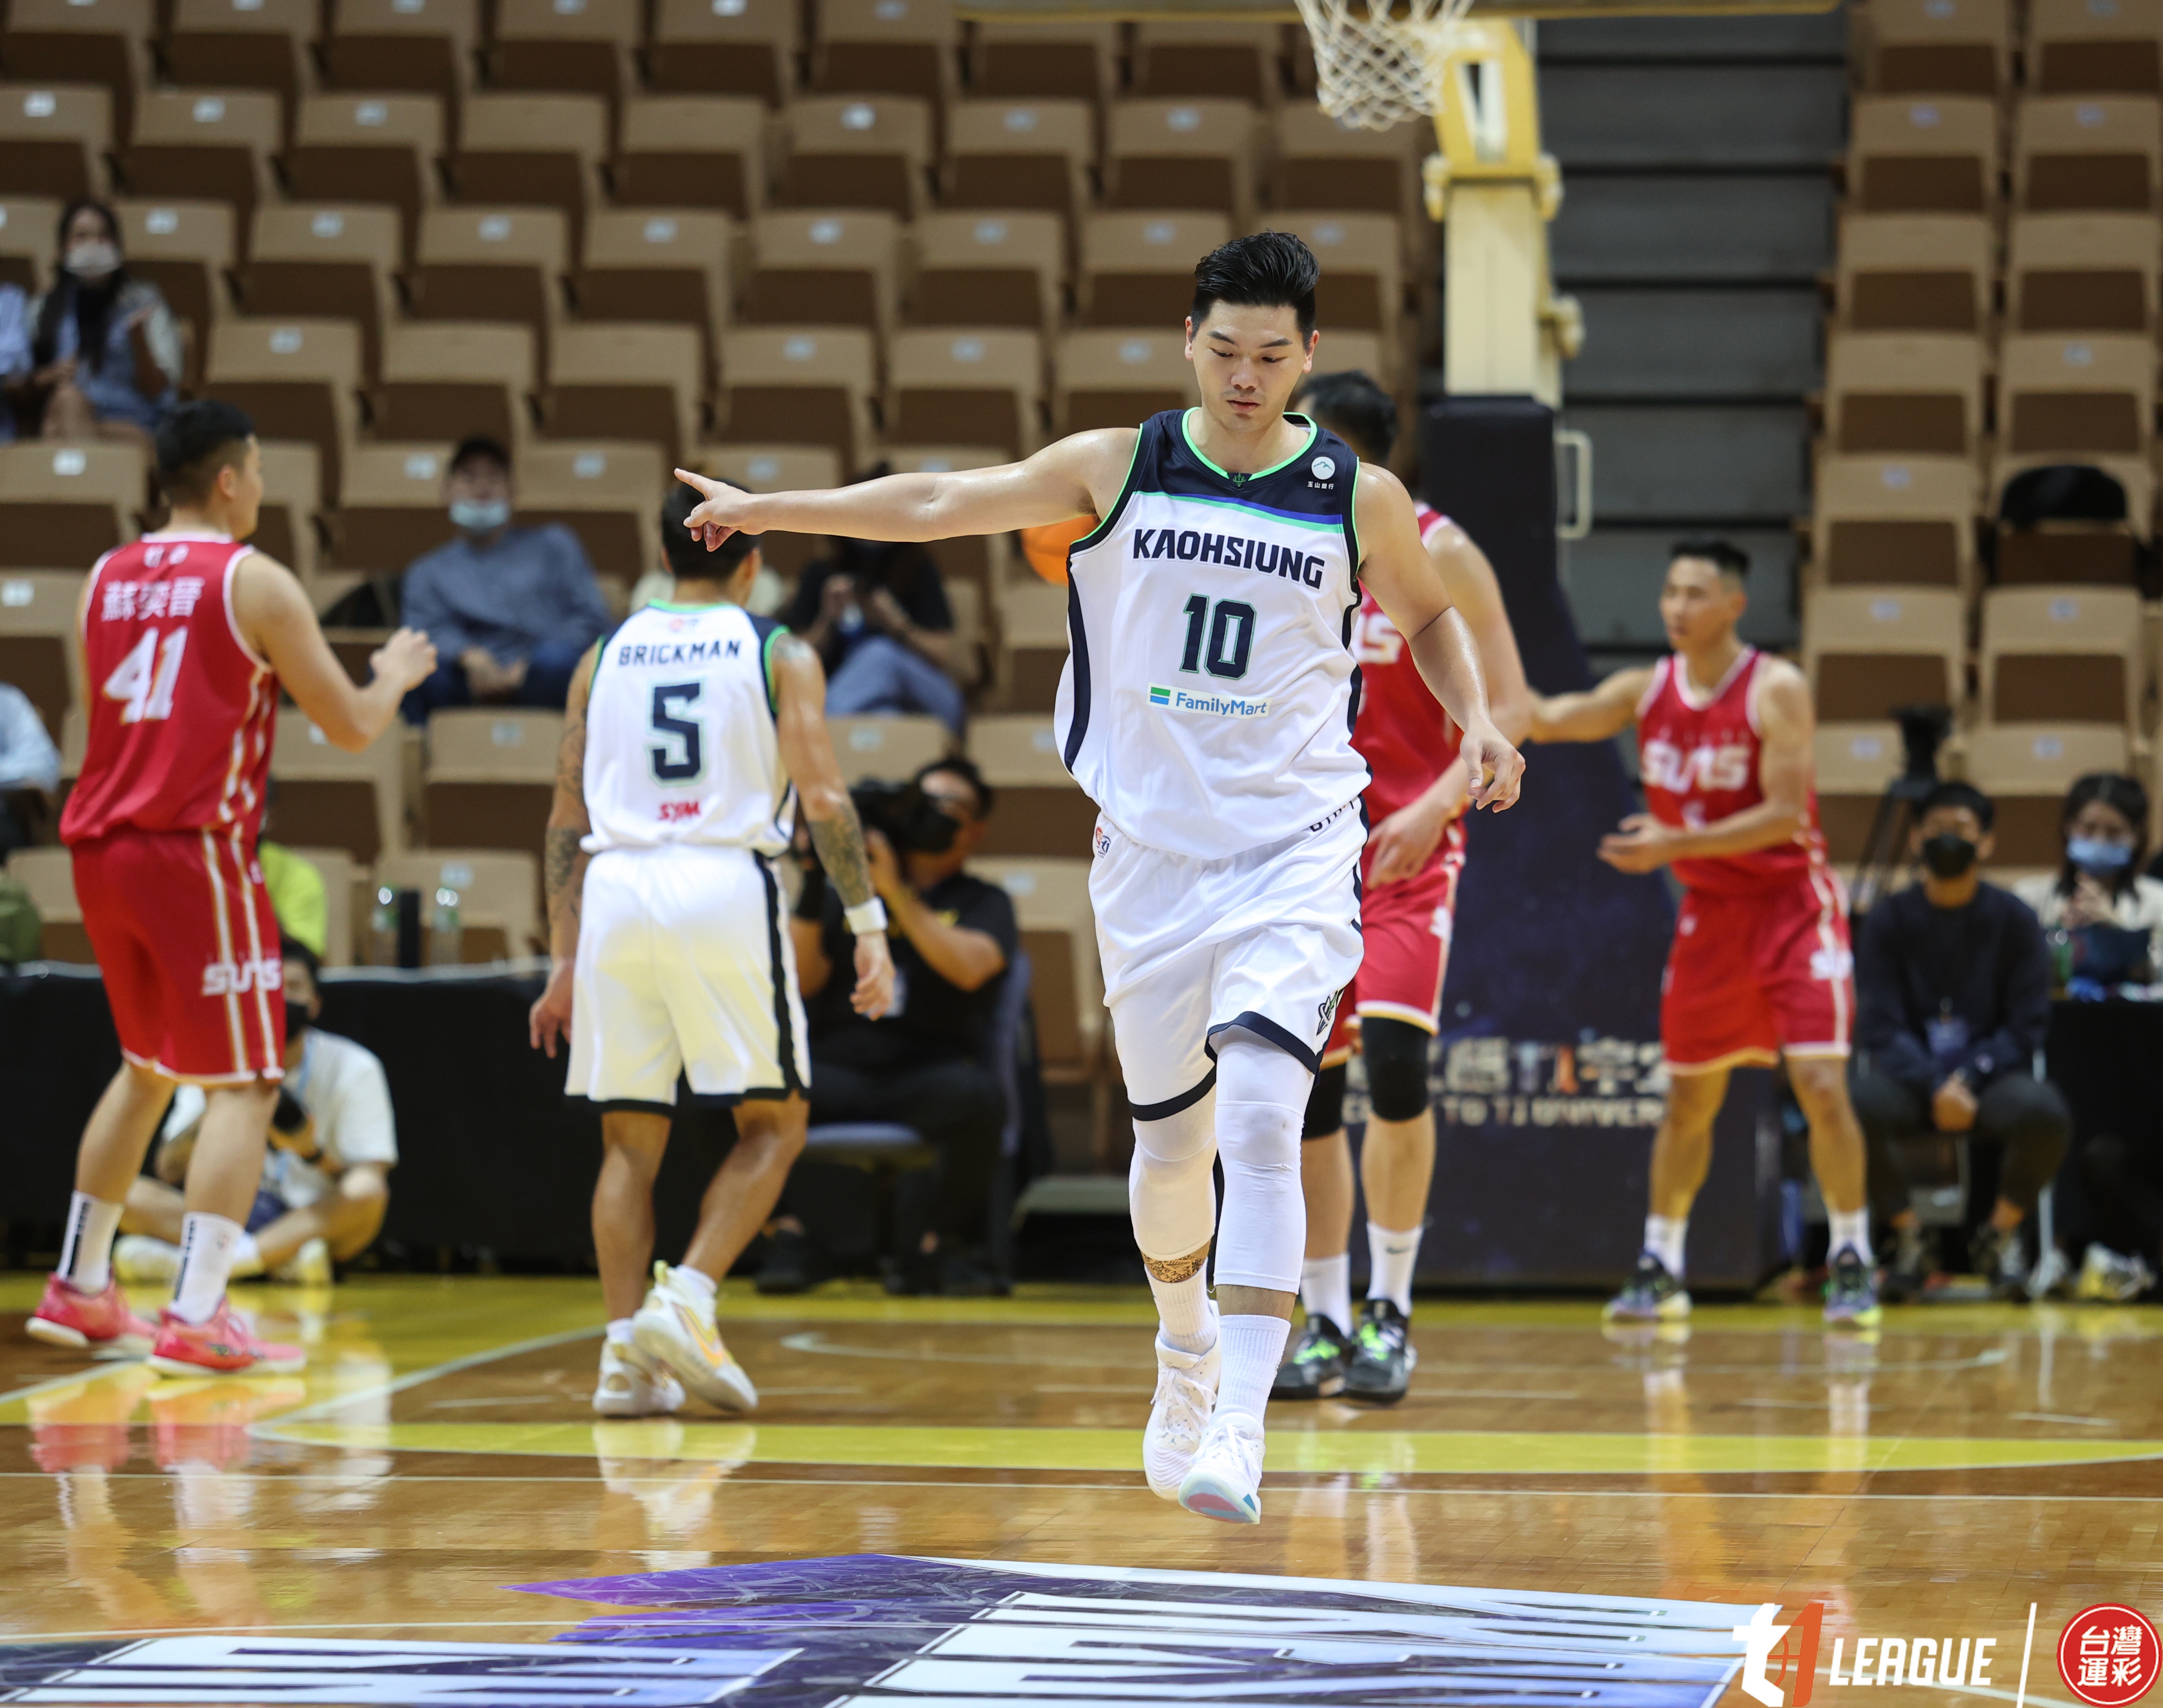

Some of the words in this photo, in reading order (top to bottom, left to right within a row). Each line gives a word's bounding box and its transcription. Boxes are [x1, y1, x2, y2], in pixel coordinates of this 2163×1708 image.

[1307, 481, 1334, 490] 玉山銀行
[1133, 529, 1325, 590] KAOHSIUNG
[618, 640, 741, 667] BRICKMAN
[1179, 594, 1256, 680] 10
[102, 626, 188, 725] 41
[1176, 692, 1267, 715] FamilyMart
[647, 677, 706, 787] 5
[658, 801, 701, 823] SYM
[829, 1553, 1783, 1708] PRES
